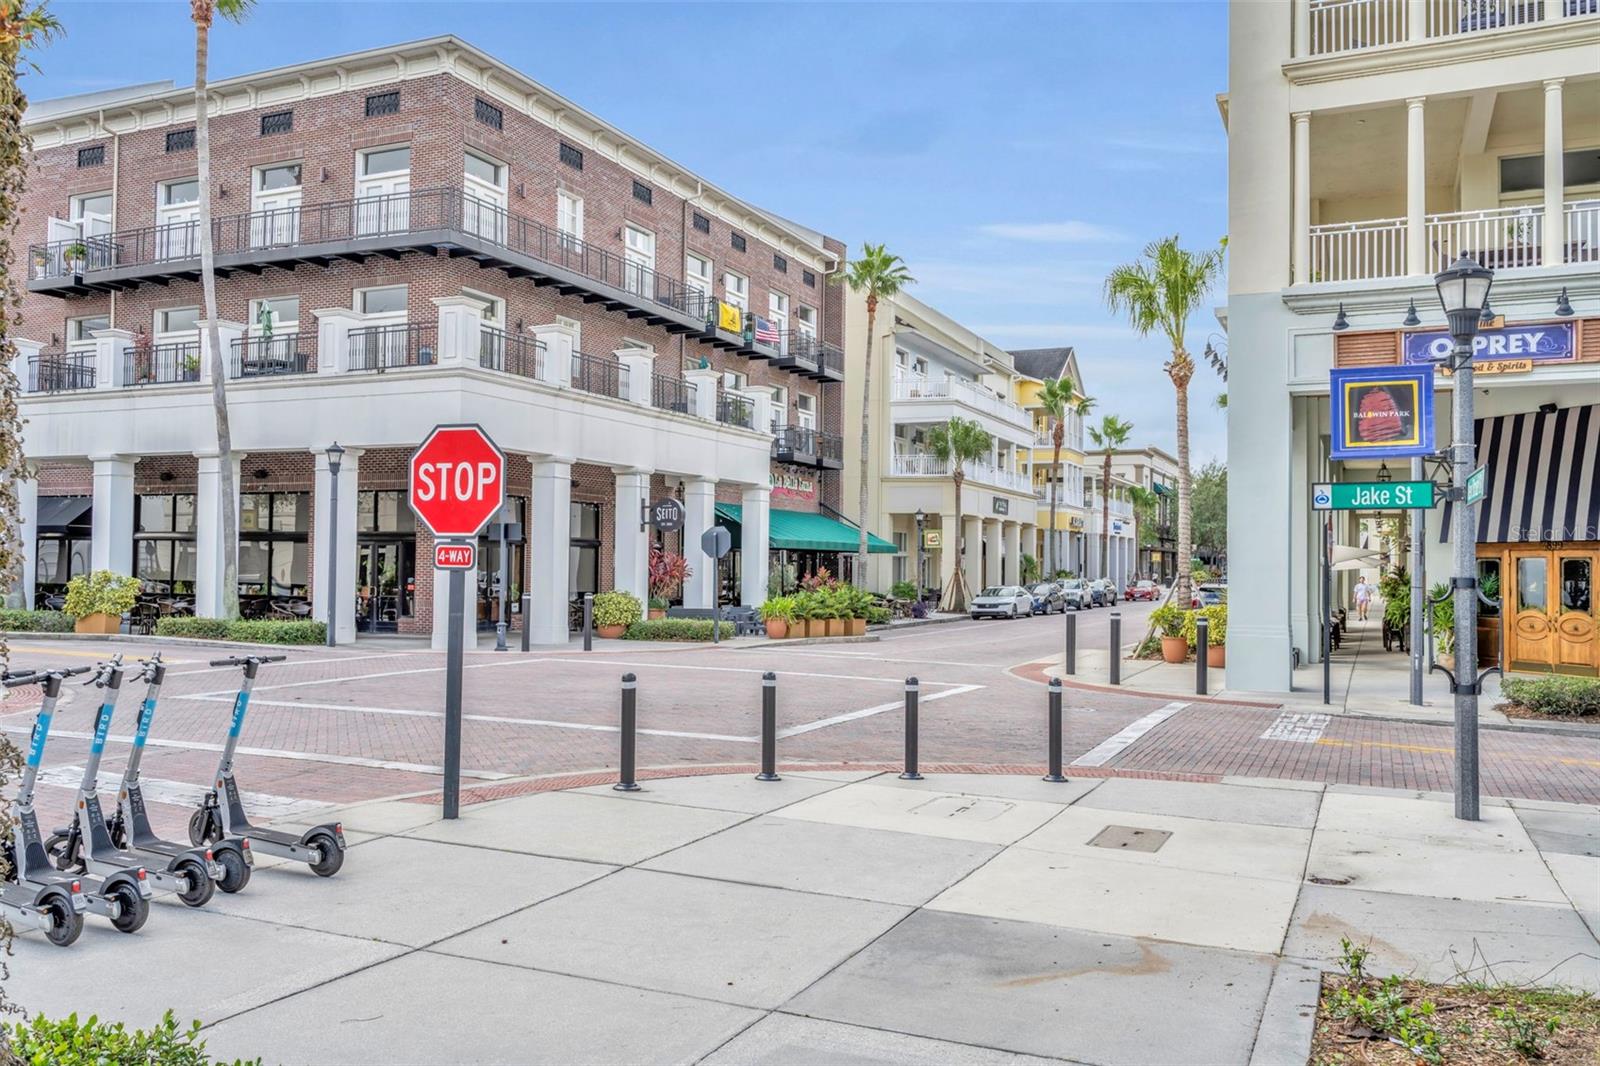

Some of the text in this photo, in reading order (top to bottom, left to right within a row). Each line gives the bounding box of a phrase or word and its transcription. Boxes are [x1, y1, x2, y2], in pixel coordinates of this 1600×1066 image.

[1430, 332, 1545, 359] OPREY
[1496, 362, 1527, 373] Spirits
[417, 462, 497, 501] STOP
[1351, 485, 1413, 505] Jake St
[656, 507, 678, 521] SEITO
[438, 550, 470, 563] 4-WAY
[95, 714, 109, 745] BIRD
[139, 708, 153, 738] BIRD
